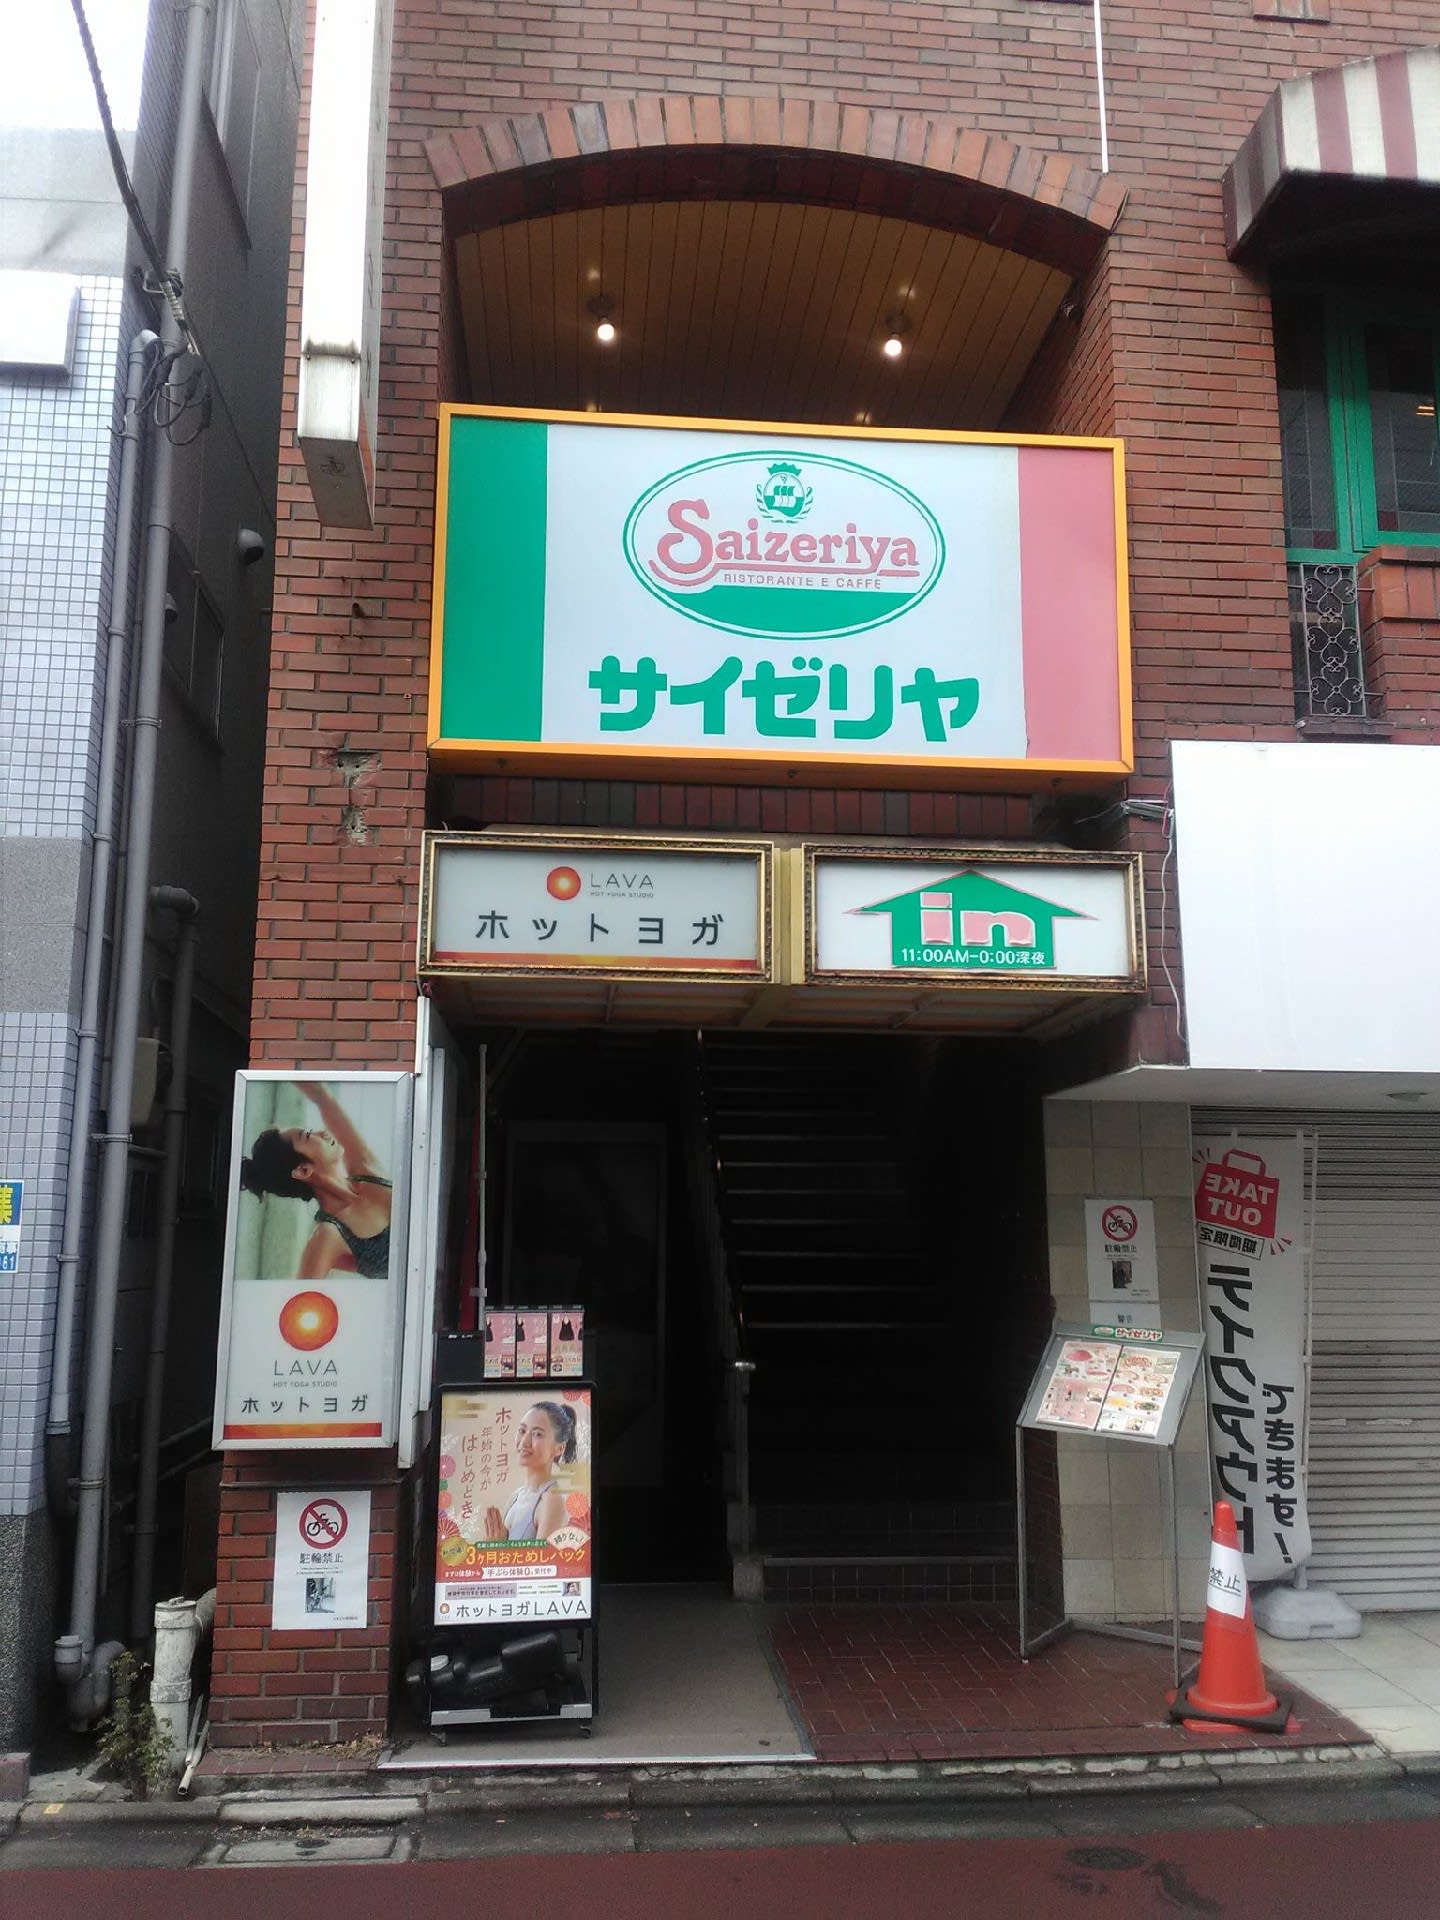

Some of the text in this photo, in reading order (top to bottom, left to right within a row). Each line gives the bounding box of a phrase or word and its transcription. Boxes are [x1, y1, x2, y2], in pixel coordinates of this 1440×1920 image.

[648, 499, 920, 587] Saizeriya
[723, 573, 815, 587] RISTORANTE
[821, 577, 828, 587] E
[588, 655, 980, 743] サイゼリヤ
[590, 872, 654, 889] LAVA
[474, 909, 725, 946] ホットヨガ
[920, 891, 1036, 948] in
[274, 1359, 338, 1376] LAVA
[241, 1393, 369, 1414] ホットヨガ
[495, 1407, 512, 1483] ホットヨガ
[300, 1552, 344, 1564] 駐輪禁止
